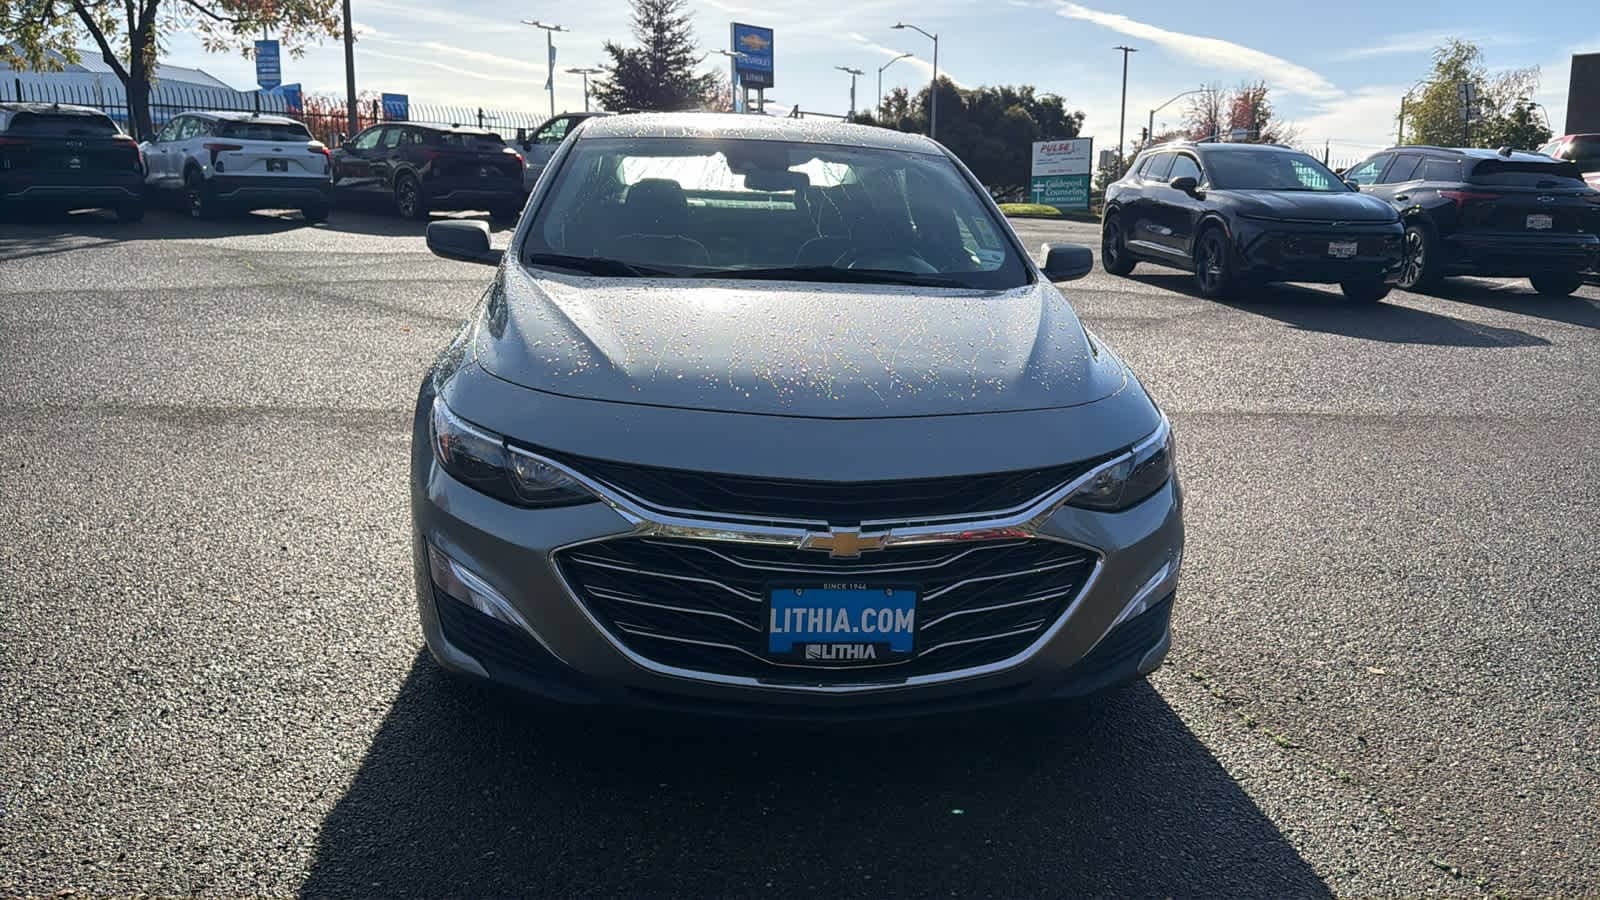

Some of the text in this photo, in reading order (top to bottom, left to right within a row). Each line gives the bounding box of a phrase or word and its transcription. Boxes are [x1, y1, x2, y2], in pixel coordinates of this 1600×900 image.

[1040, 143, 1071, 153] PULSE
[769, 607, 916, 633] LITHIA.COM
[822, 644, 877, 660] LITHIA
